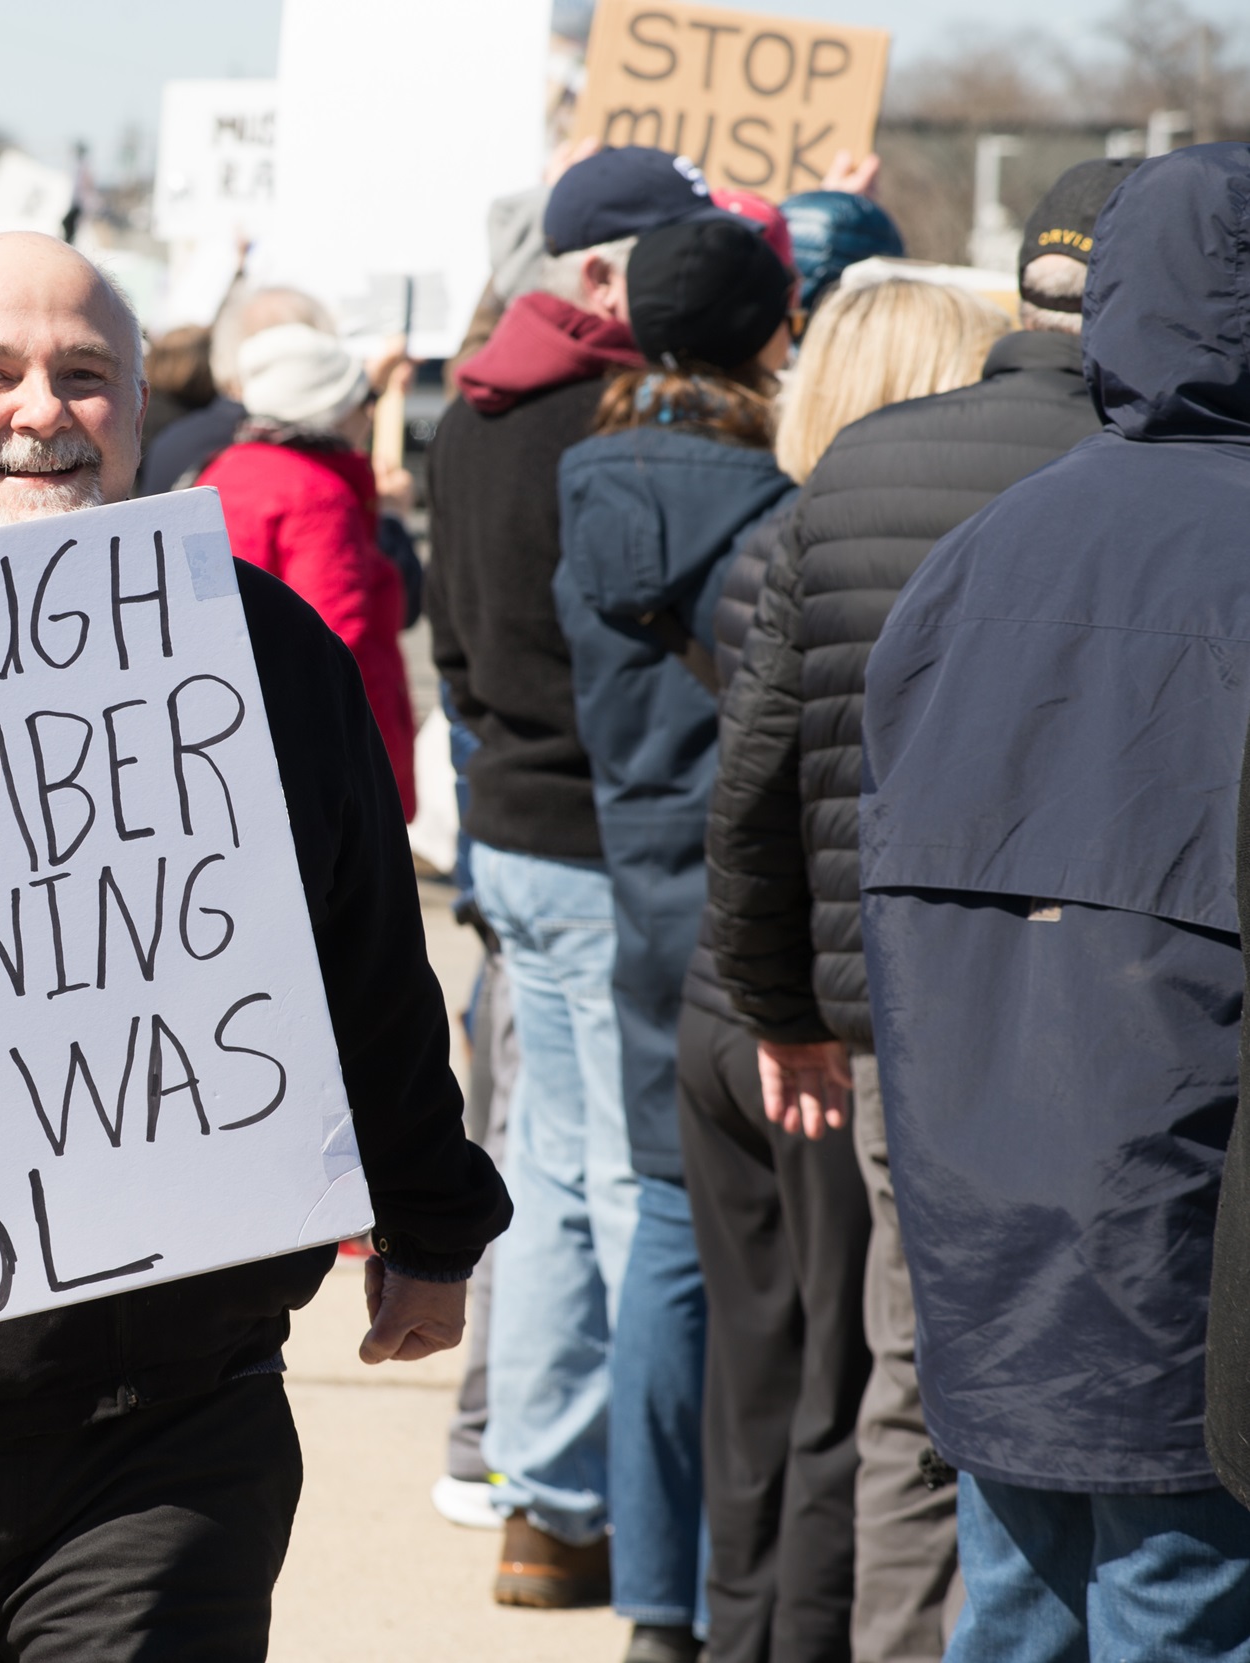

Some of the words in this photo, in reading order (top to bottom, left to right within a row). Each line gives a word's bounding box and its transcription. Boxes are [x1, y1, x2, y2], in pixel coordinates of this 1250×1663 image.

[620, 11, 852, 105] STOP
[1038, 229, 1093, 252] ORVIS
[8, 992, 287, 1157] WAS
